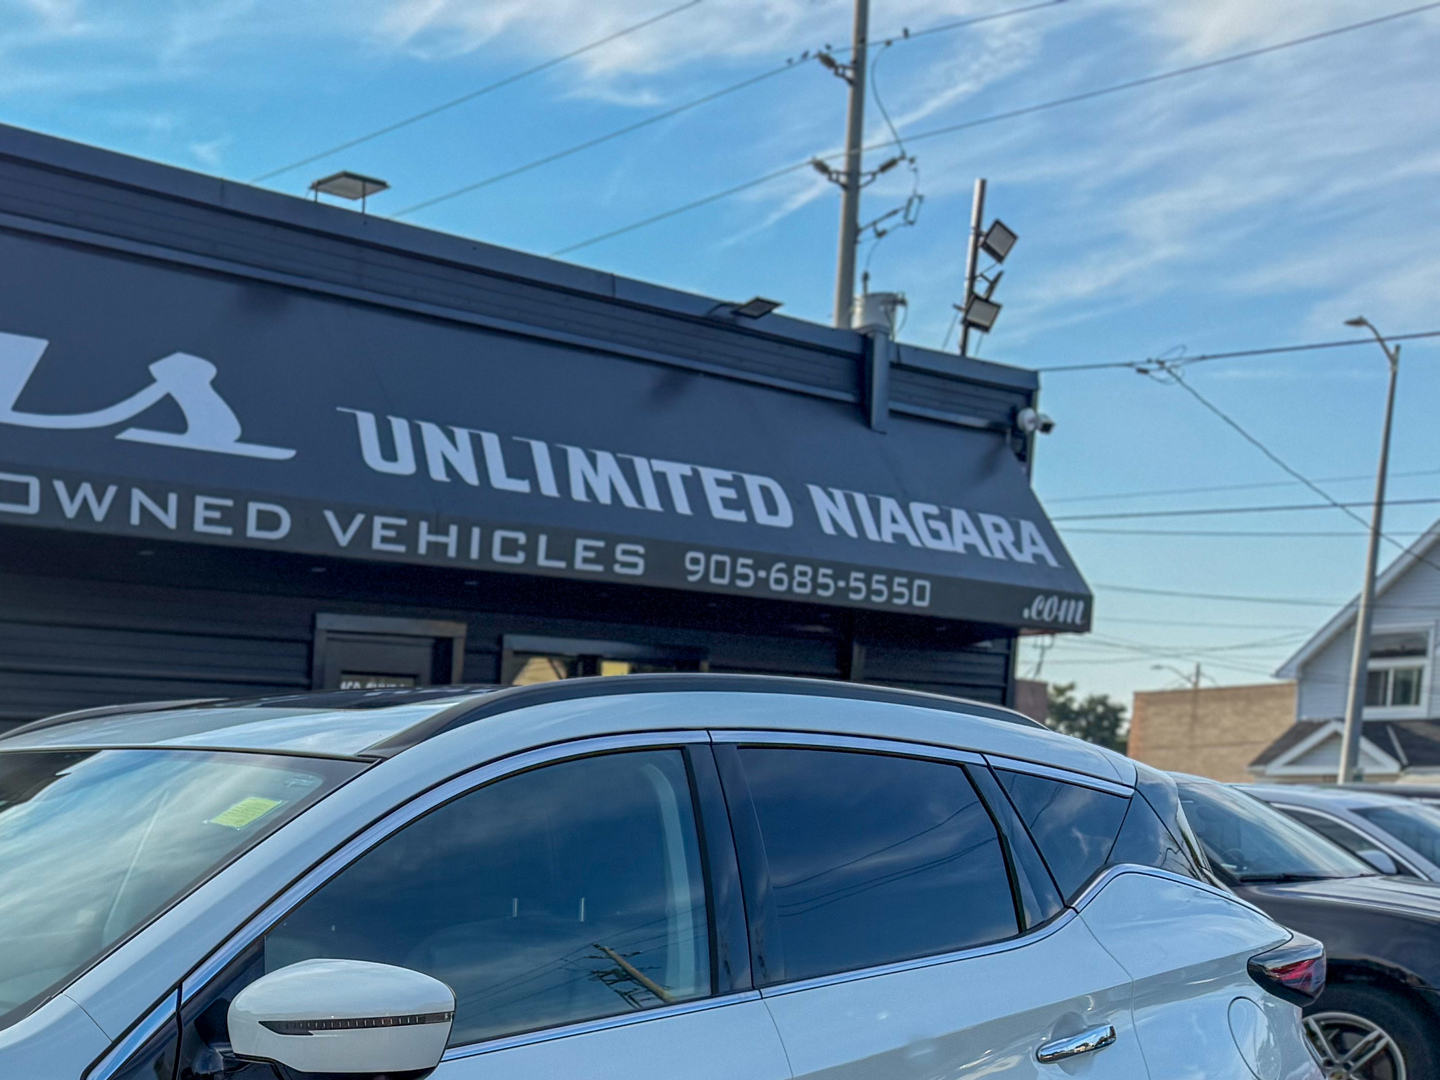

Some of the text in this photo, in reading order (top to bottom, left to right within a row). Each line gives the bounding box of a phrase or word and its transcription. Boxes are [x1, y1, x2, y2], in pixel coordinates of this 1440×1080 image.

[336, 406, 1062, 568] UNLIMITED NIAGARA
[323, 509, 646, 576] VEHICLES
[684, 551, 931, 607] 905-685-5550
[1023, 594, 1087, 625] .com
